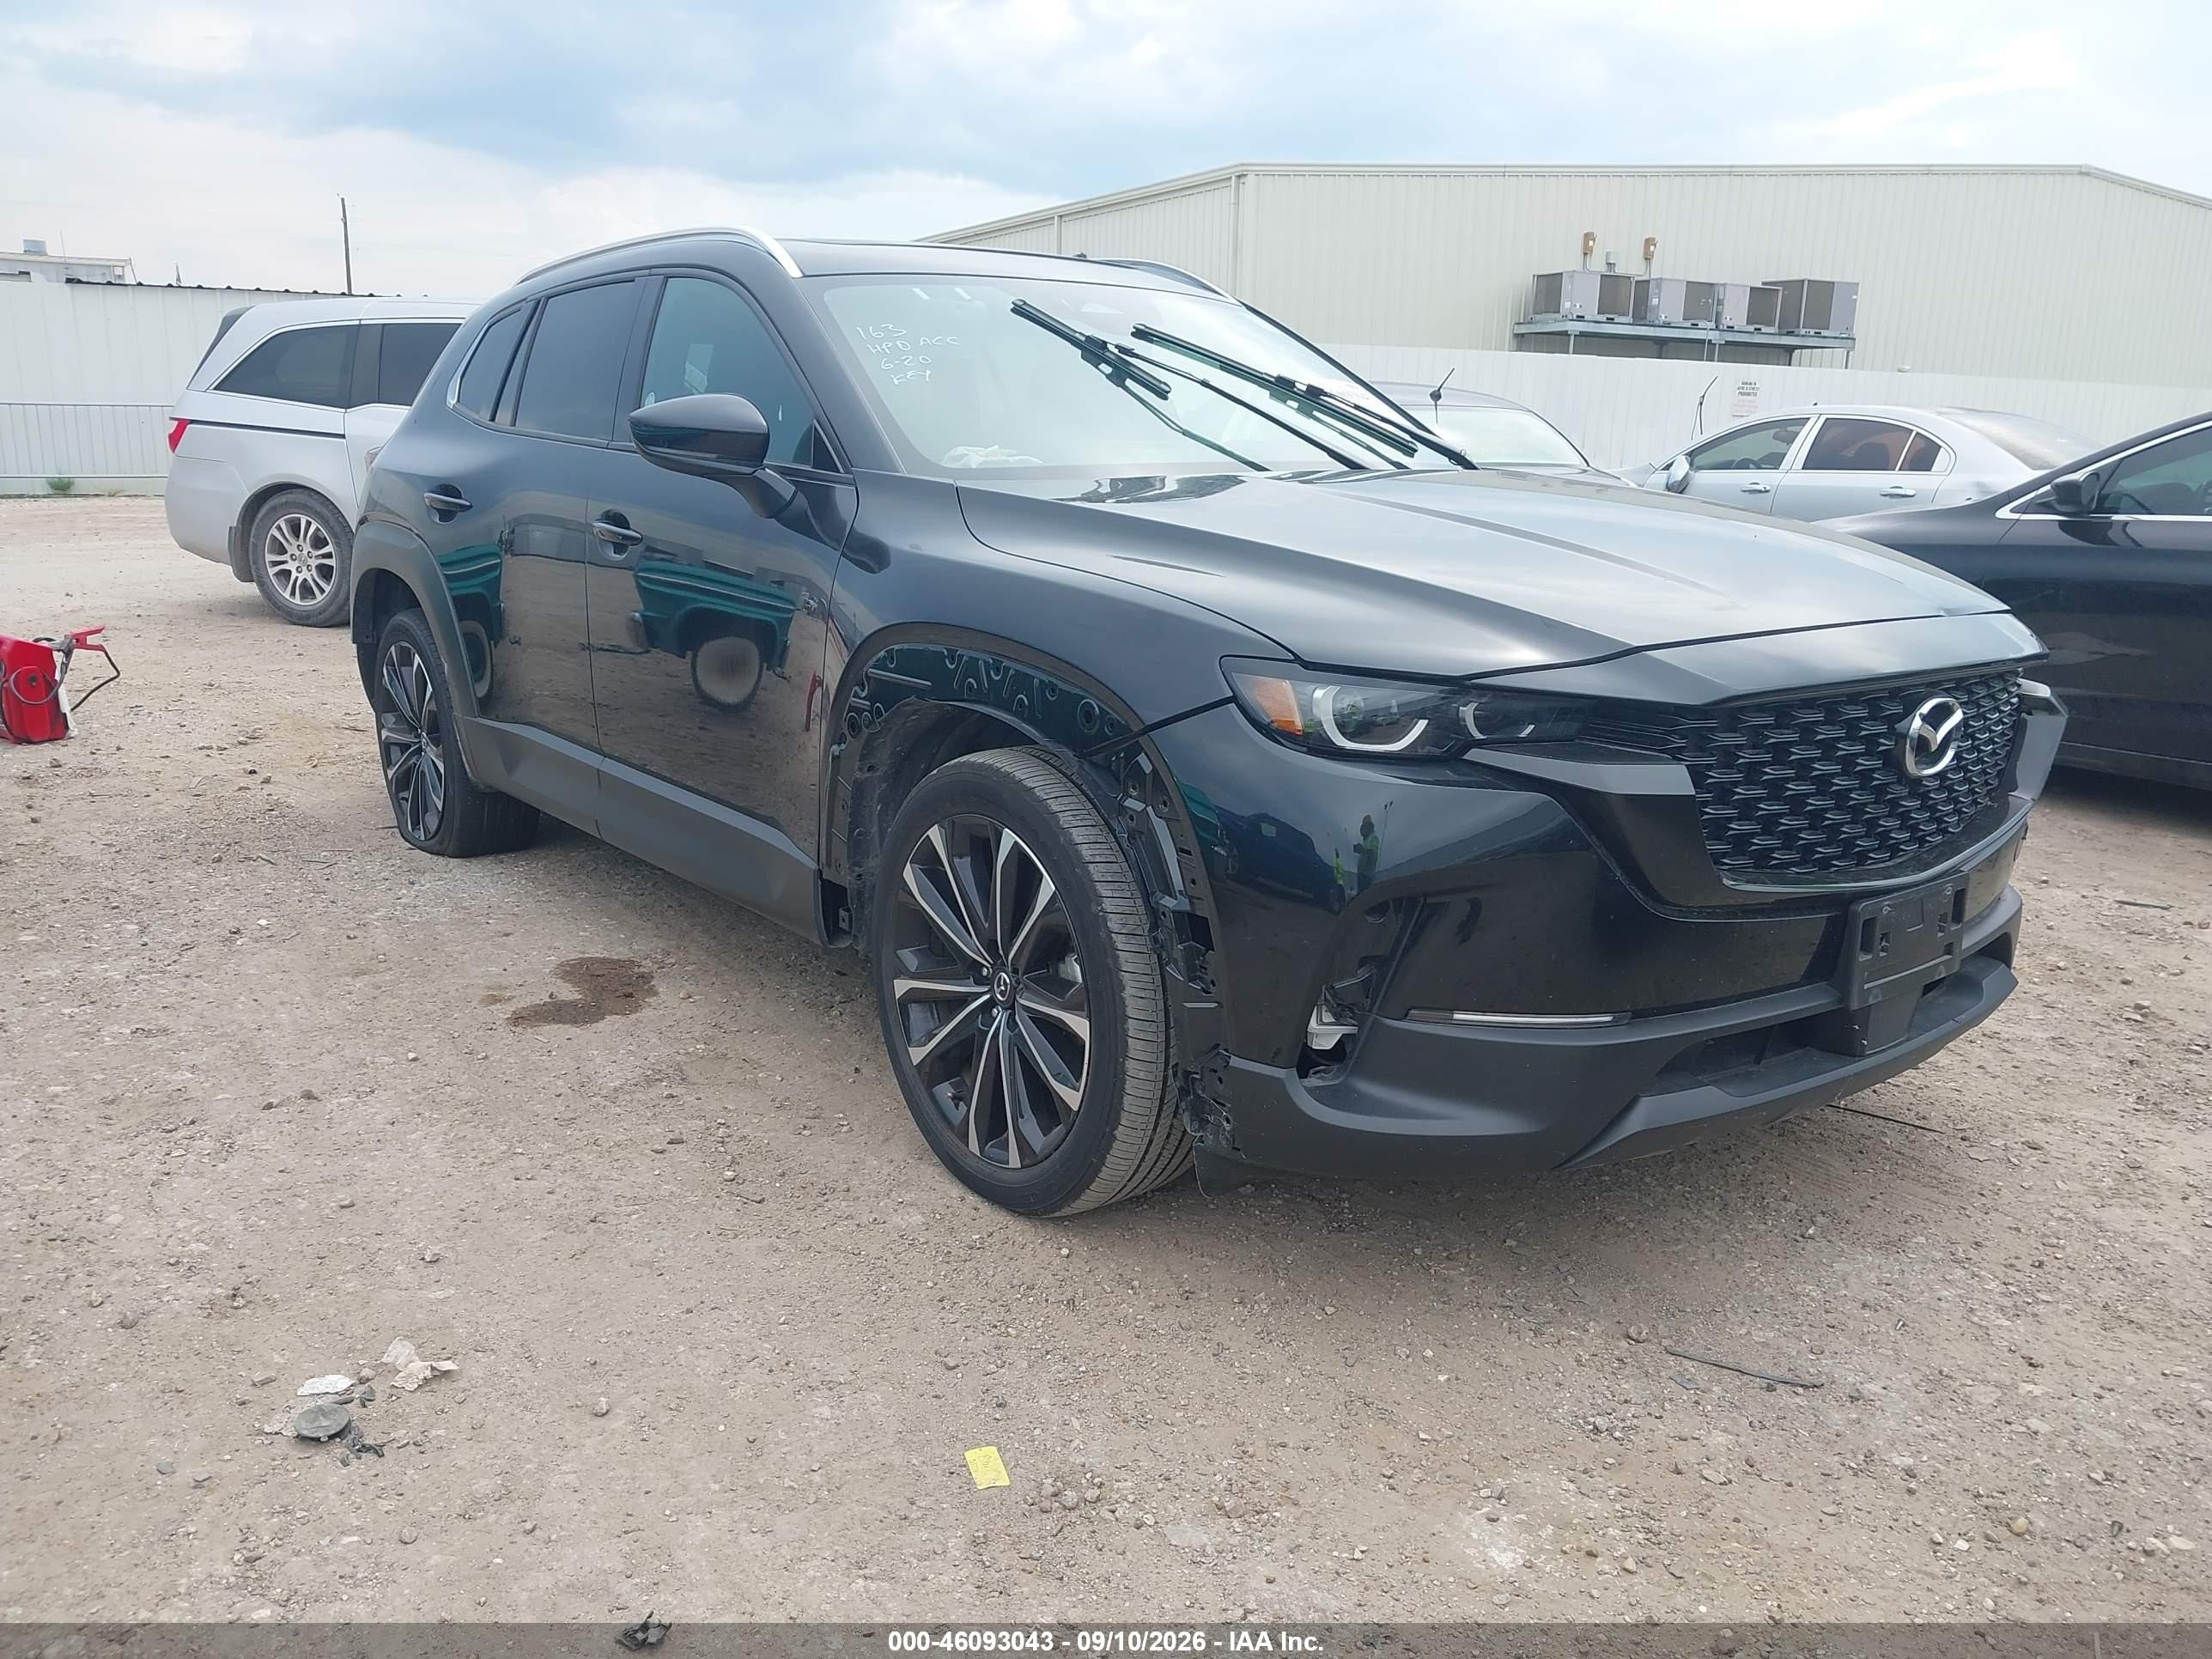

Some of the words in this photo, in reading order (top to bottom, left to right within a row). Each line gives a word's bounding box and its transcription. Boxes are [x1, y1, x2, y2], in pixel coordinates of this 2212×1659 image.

[856, 324, 907, 340] 163
[919, 336, 962, 347] ACC
[890, 370, 932, 385] KEY
